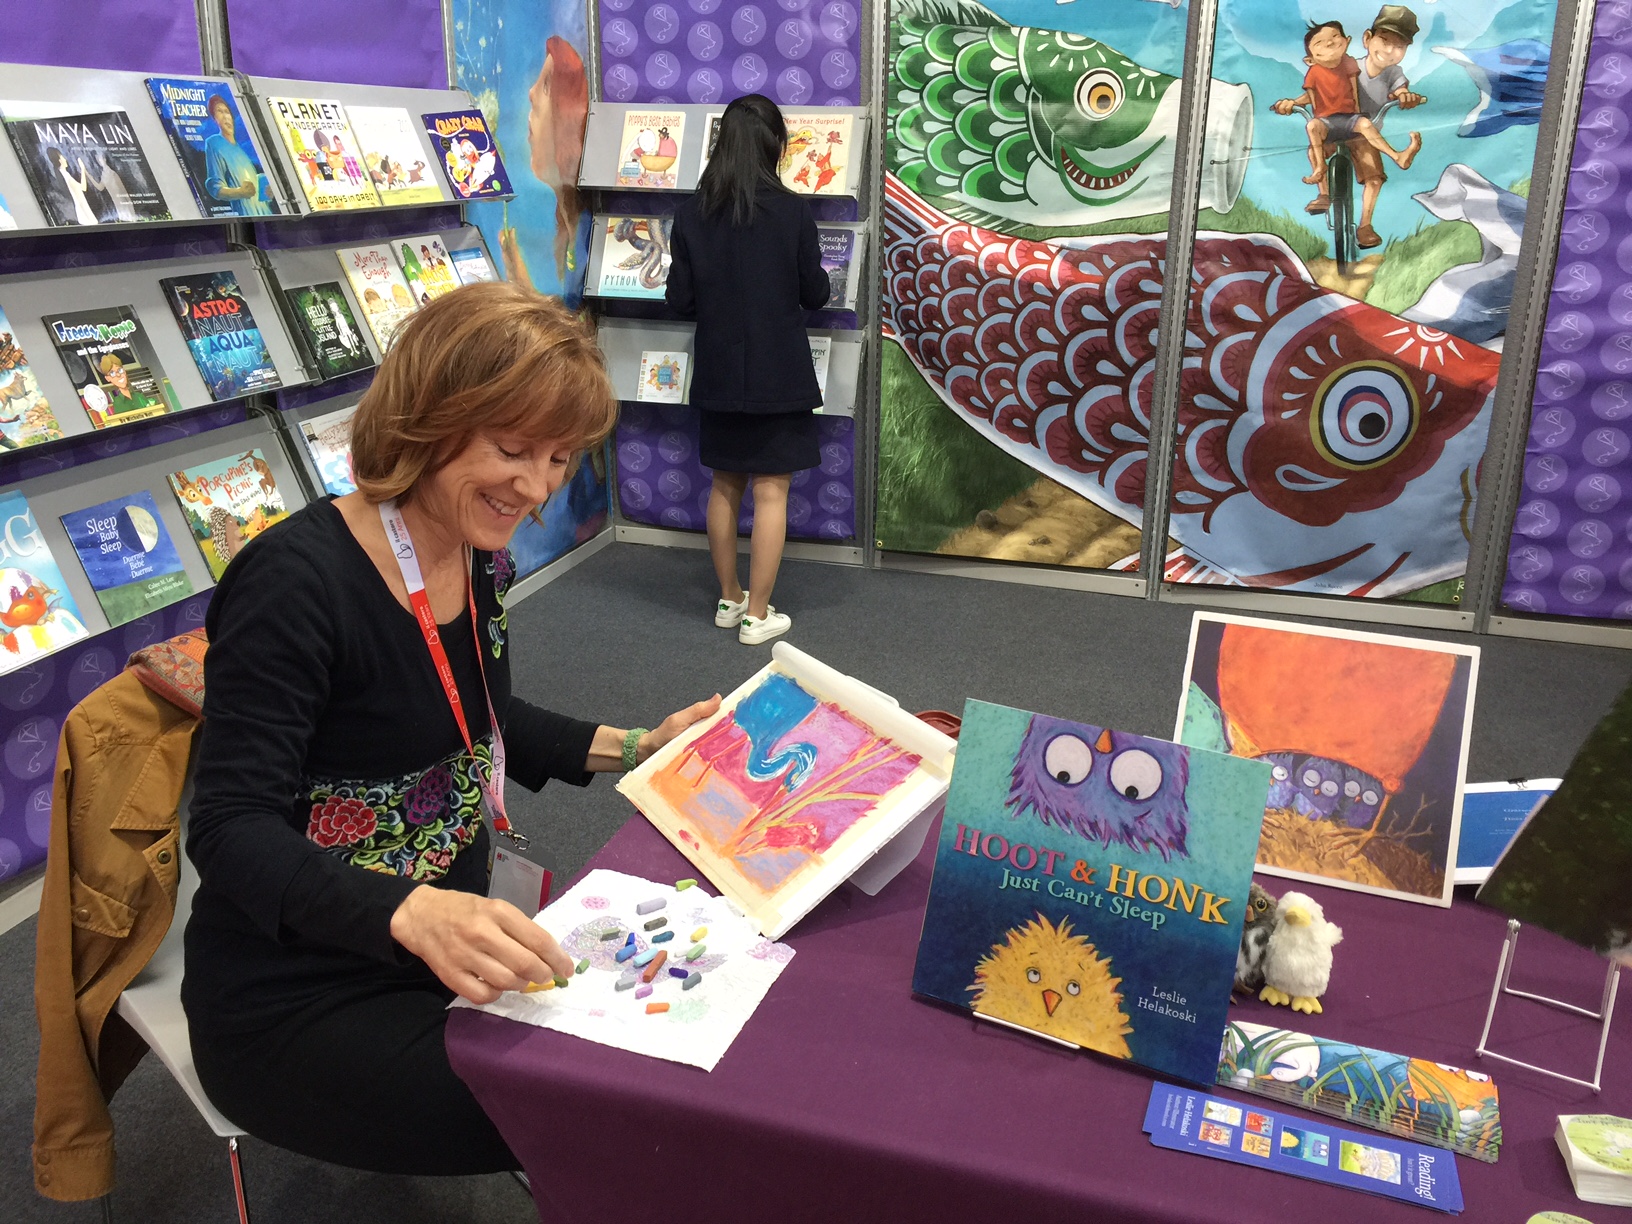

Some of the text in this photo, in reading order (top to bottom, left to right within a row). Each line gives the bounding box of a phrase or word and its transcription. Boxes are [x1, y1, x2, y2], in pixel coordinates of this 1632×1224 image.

[160, 83, 206, 104] MIDNIGHT
[168, 100, 209, 117] TEACHER
[277, 101, 341, 120] PLANET
[285, 121, 348, 131] KINDERGARTEN
[799, 117, 814, 125] Year
[815, 117, 846, 126] Surprise!
[34, 122, 135, 145] MAYA LIN
[820, 234, 848, 243] Sounds
[819, 243, 848, 254] Spooky
[354, 250, 389, 268] More Than
[361, 262, 392, 280] Enough
[604, 275, 638, 287] PYTHON
[192, 298, 241, 319] ASTRO-
[306, 303, 328, 319] HELLO
[52, 320, 99, 343] Freddy
[195, 313, 246, 338] NAUT
[211, 346, 264, 373] NAUT
[86, 515, 118, 535] Sleep
[100, 529, 120, 543] Baby
[100, 541, 122, 555] Sleep
[123, 551, 146, 565] Duerme
[131, 565, 154, 579] Duerme
[952, 823, 1232, 926] HOOT & HONK
[999, 867, 1167, 932] Just Can't Sleep
[1152, 985, 1188, 1006] Leslie
[1136, 996, 1197, 1025] Helakoski
[1414, 1152, 1437, 1202] Reading!
